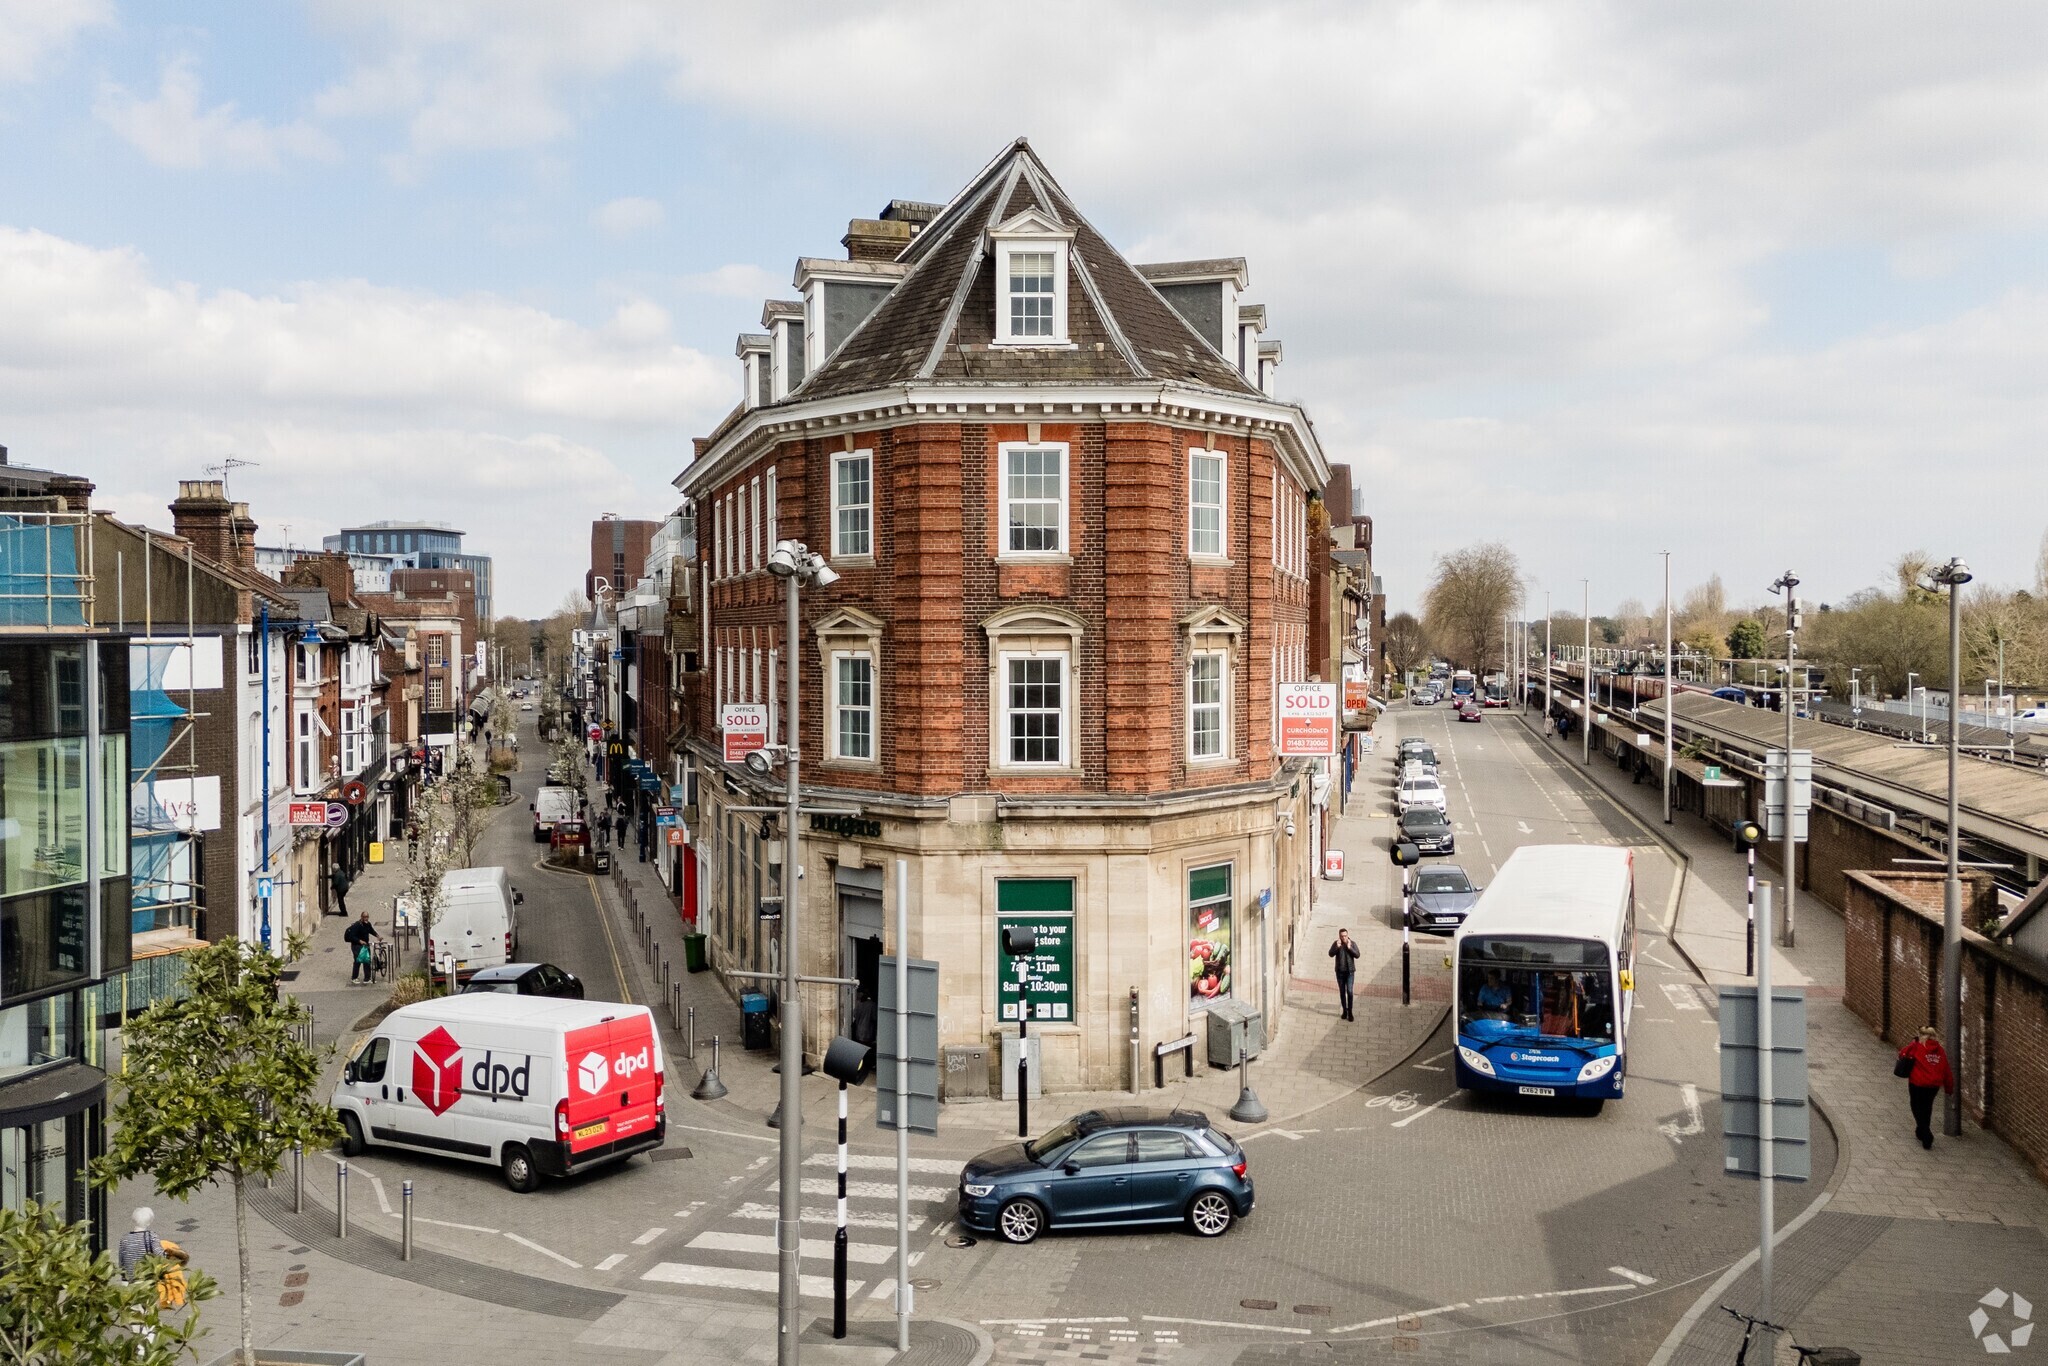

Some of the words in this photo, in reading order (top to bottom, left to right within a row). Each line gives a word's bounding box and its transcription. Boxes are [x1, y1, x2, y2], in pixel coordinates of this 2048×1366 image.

[1285, 695, 1330, 709] SOLD
[1346, 699, 1366, 708] OPEN
[726, 715, 760, 726] SOLD
[1039, 924, 1048, 934] to
[1049, 926, 1067, 935] your
[1040, 936, 1061, 945] store
[1036, 961, 1060, 974] 11pm
[1030, 981, 1068, 994] 10:30pm
[615, 1047, 648, 1078] dpd
[1521, 1053, 1560, 1063] Stagecoach
[472, 1050, 531, 1102] dpd
